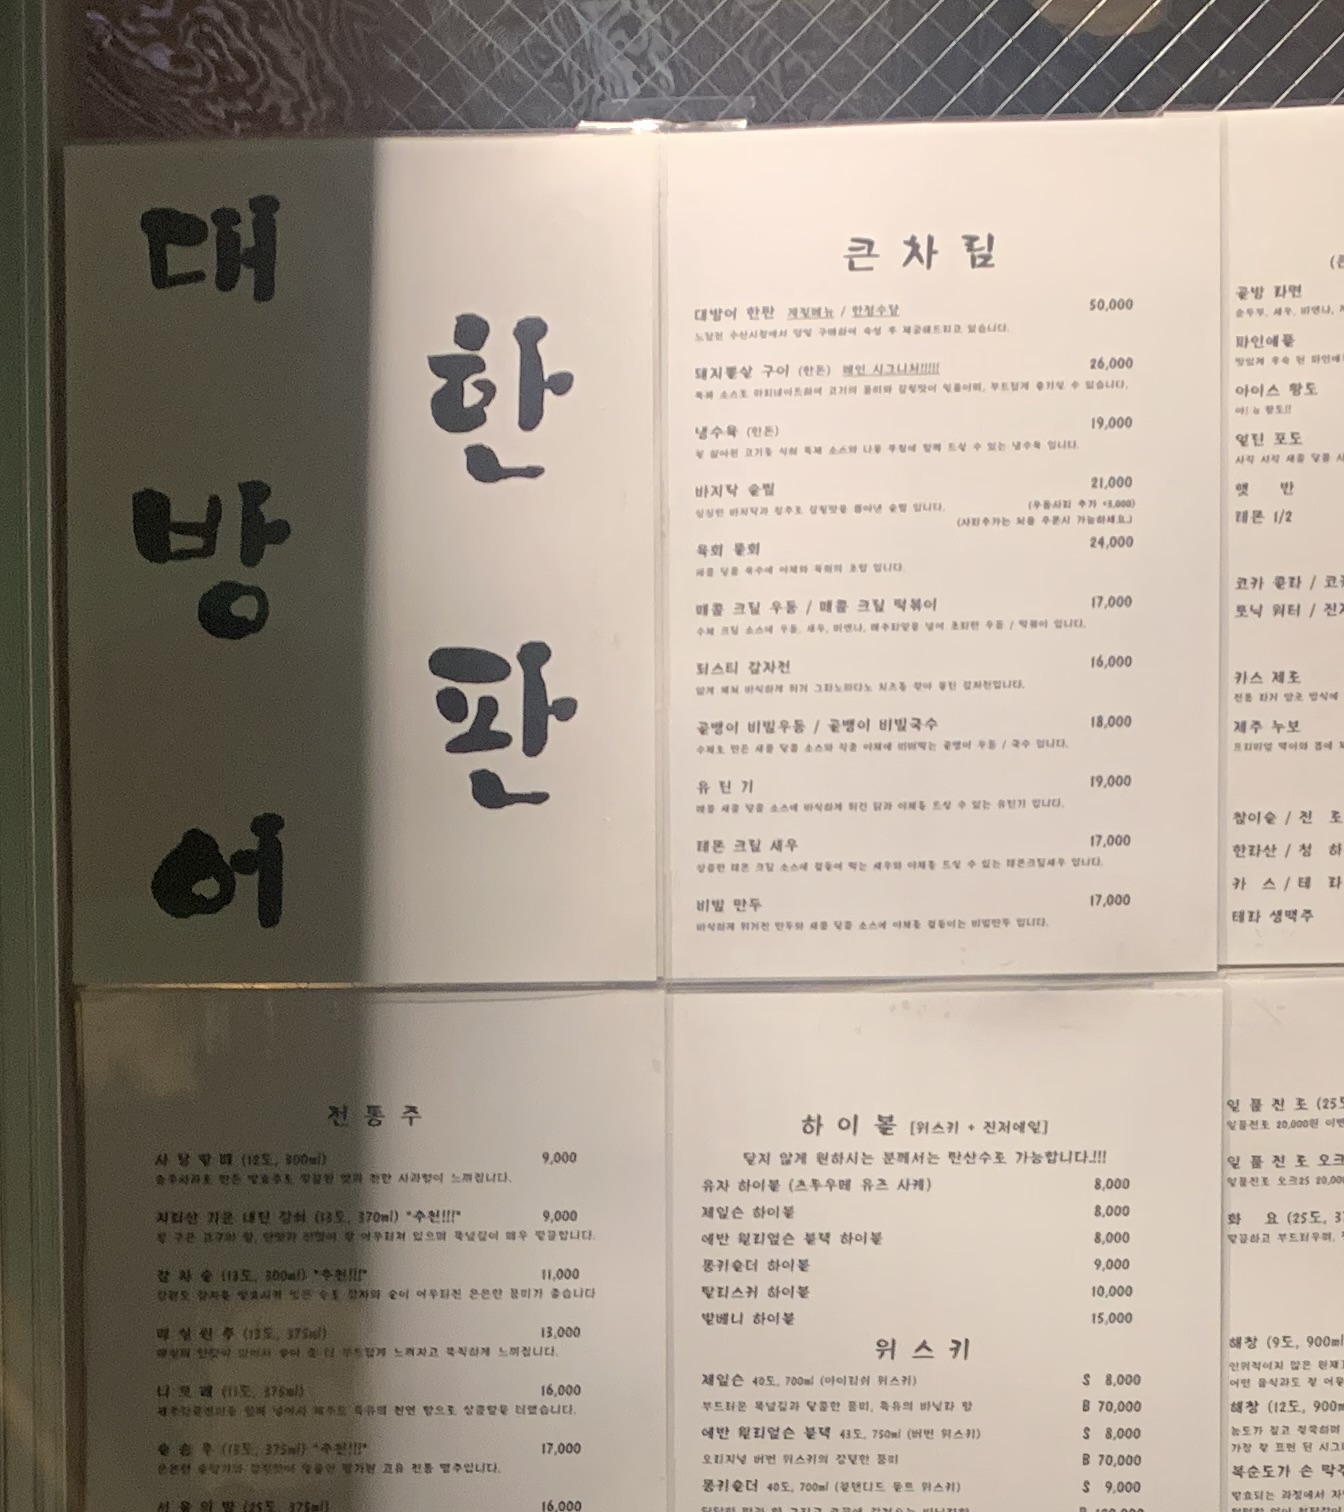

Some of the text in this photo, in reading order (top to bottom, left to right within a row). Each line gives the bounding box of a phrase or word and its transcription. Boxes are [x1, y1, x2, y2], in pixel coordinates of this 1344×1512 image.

[694, 297, 1134, 323] 대방어 한판 50,000
[763, 356, 1134, 378] 구이 26,000
[1234, 383, 1280, 398] 아이스
[1091, 415, 1134, 430] 19,000
[1274, 431, 1303, 446] 포도
[1090, 475, 1133, 490] 21,000
[1273, 509, 1293, 525] 1/2
[1089, 535, 1135, 550] 24,000
[1235, 575, 1265, 591] 코카
[1091, 594, 1133, 610] 17,000
[1090, 654, 1133, 670] 16,000
[1234, 670, 1264, 685] 카스
[1090, 714, 1133, 729] 18,000
[1233, 719, 1263, 735] 제주
[1271, 719, 1300, 735] 누보
[1090, 774, 1132, 789] 19,000
[1232, 810, 1277, 826] 참이슬
[769, 833, 1132, 853] 새우 17,000
[1232, 843, 1278, 859] 한라산
[732, 893, 1132, 913] 만두 17,000
[541, 1150, 578, 1166] 9,000
[815, 1151, 875, 1166] 원하시는
[702, 1177, 1131, 1194] 유자 하이볼 8,000
[542, 1209, 579, 1224] 9,000
[752, 1204, 1131, 1220] 하이볼 8,000
[700, 1230, 1131, 1247] 에반 하이볼 8,000
[1093, 1257, 1131, 1272] 9,000
[541, 1267, 581, 1282] 11,000
[1091, 1284, 1134, 1299] 10,000
[1091, 1311, 1134, 1326] 15,000
[540, 1325, 582, 1340] 13,000
[1104, 1373, 1142, 1388] 8,000
[540, 1383, 582, 1398] 16,000
[1097, 1399, 1143, 1415] 70,000
[1104, 1426, 1142, 1441] 8,000
[541, 1441, 583, 1457] 17,000
[1097, 1453, 1143, 1468] 70,000
[1104, 1480, 1142, 1495] 9,000
